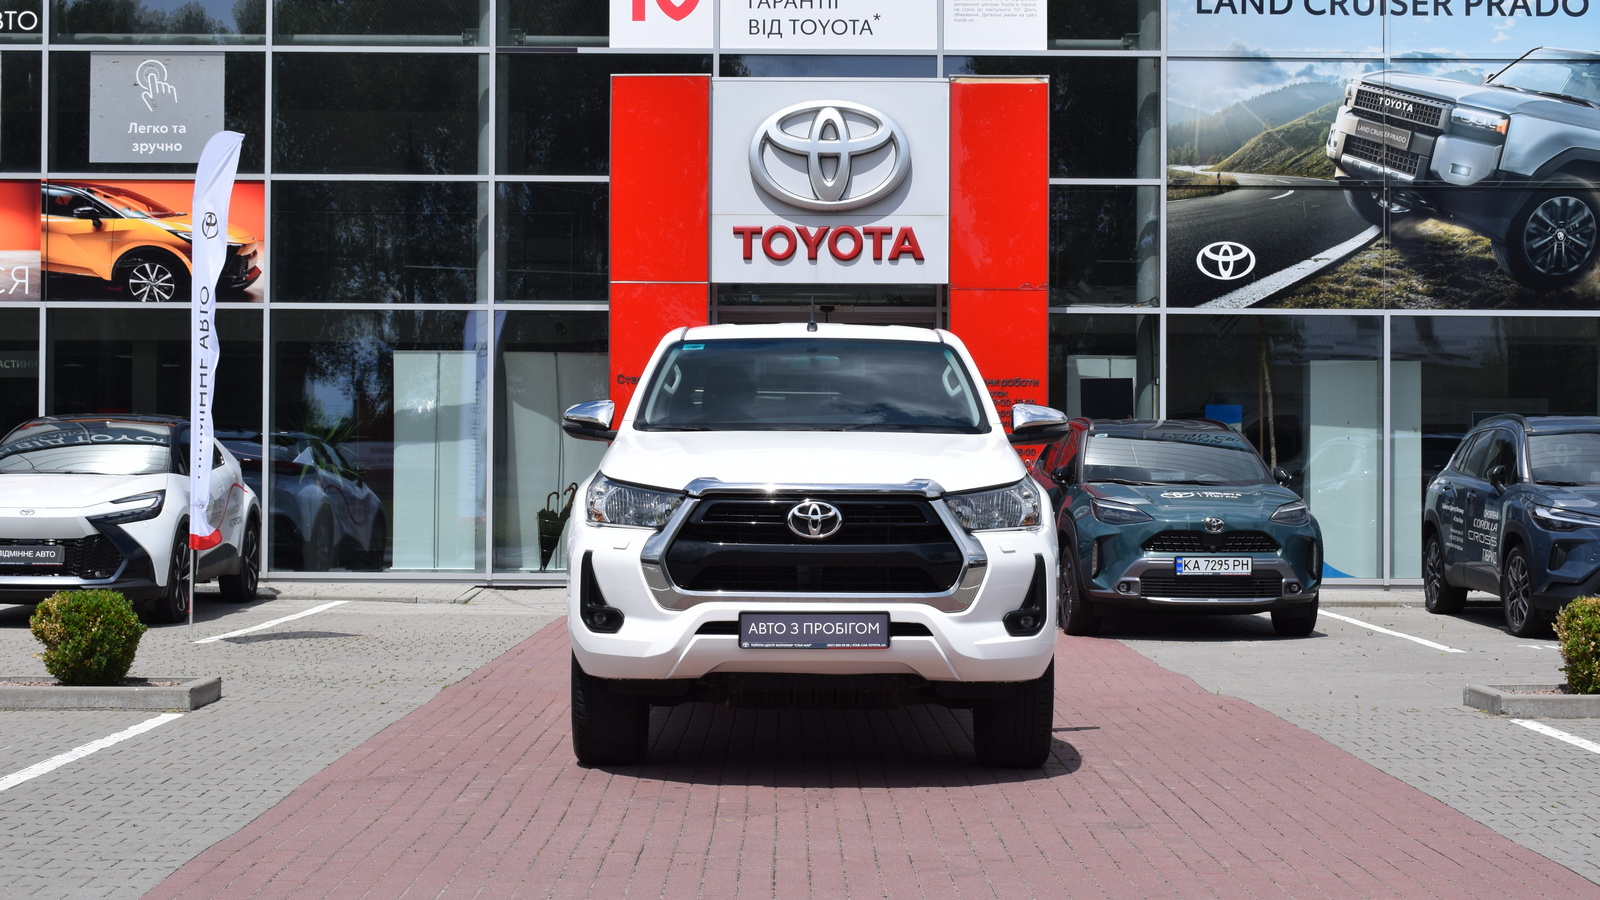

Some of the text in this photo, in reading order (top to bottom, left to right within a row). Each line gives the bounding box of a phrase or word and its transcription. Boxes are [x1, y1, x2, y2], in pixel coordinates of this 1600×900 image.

[1196, 0, 1589, 18] LAND CRUISER PRADO
[748, 19, 783, 38] ВІД
[1379, 97, 1413, 112] TOYOTA
[127, 122, 187, 134] Легко та
[1357, 125, 1370, 133] LAND
[1390, 133, 1407, 143] PRADO
[131, 142, 182, 155] зручно
[732, 225, 925, 262] TOYOTA
[0, 265, 29, 295] Я
[617, 374, 641, 385] Ста
[1001, 376, 1040, 389] роботи
[1473, 518, 1498, 532] COROLLA
[1468, 530, 1498, 547] CROSS
[35, 550, 56, 558] АВТО
[1204, 559, 1230, 571] 7295
[748, 622, 787, 635] АВТО
[803, 622, 880, 635] ПРОБІГОМ
